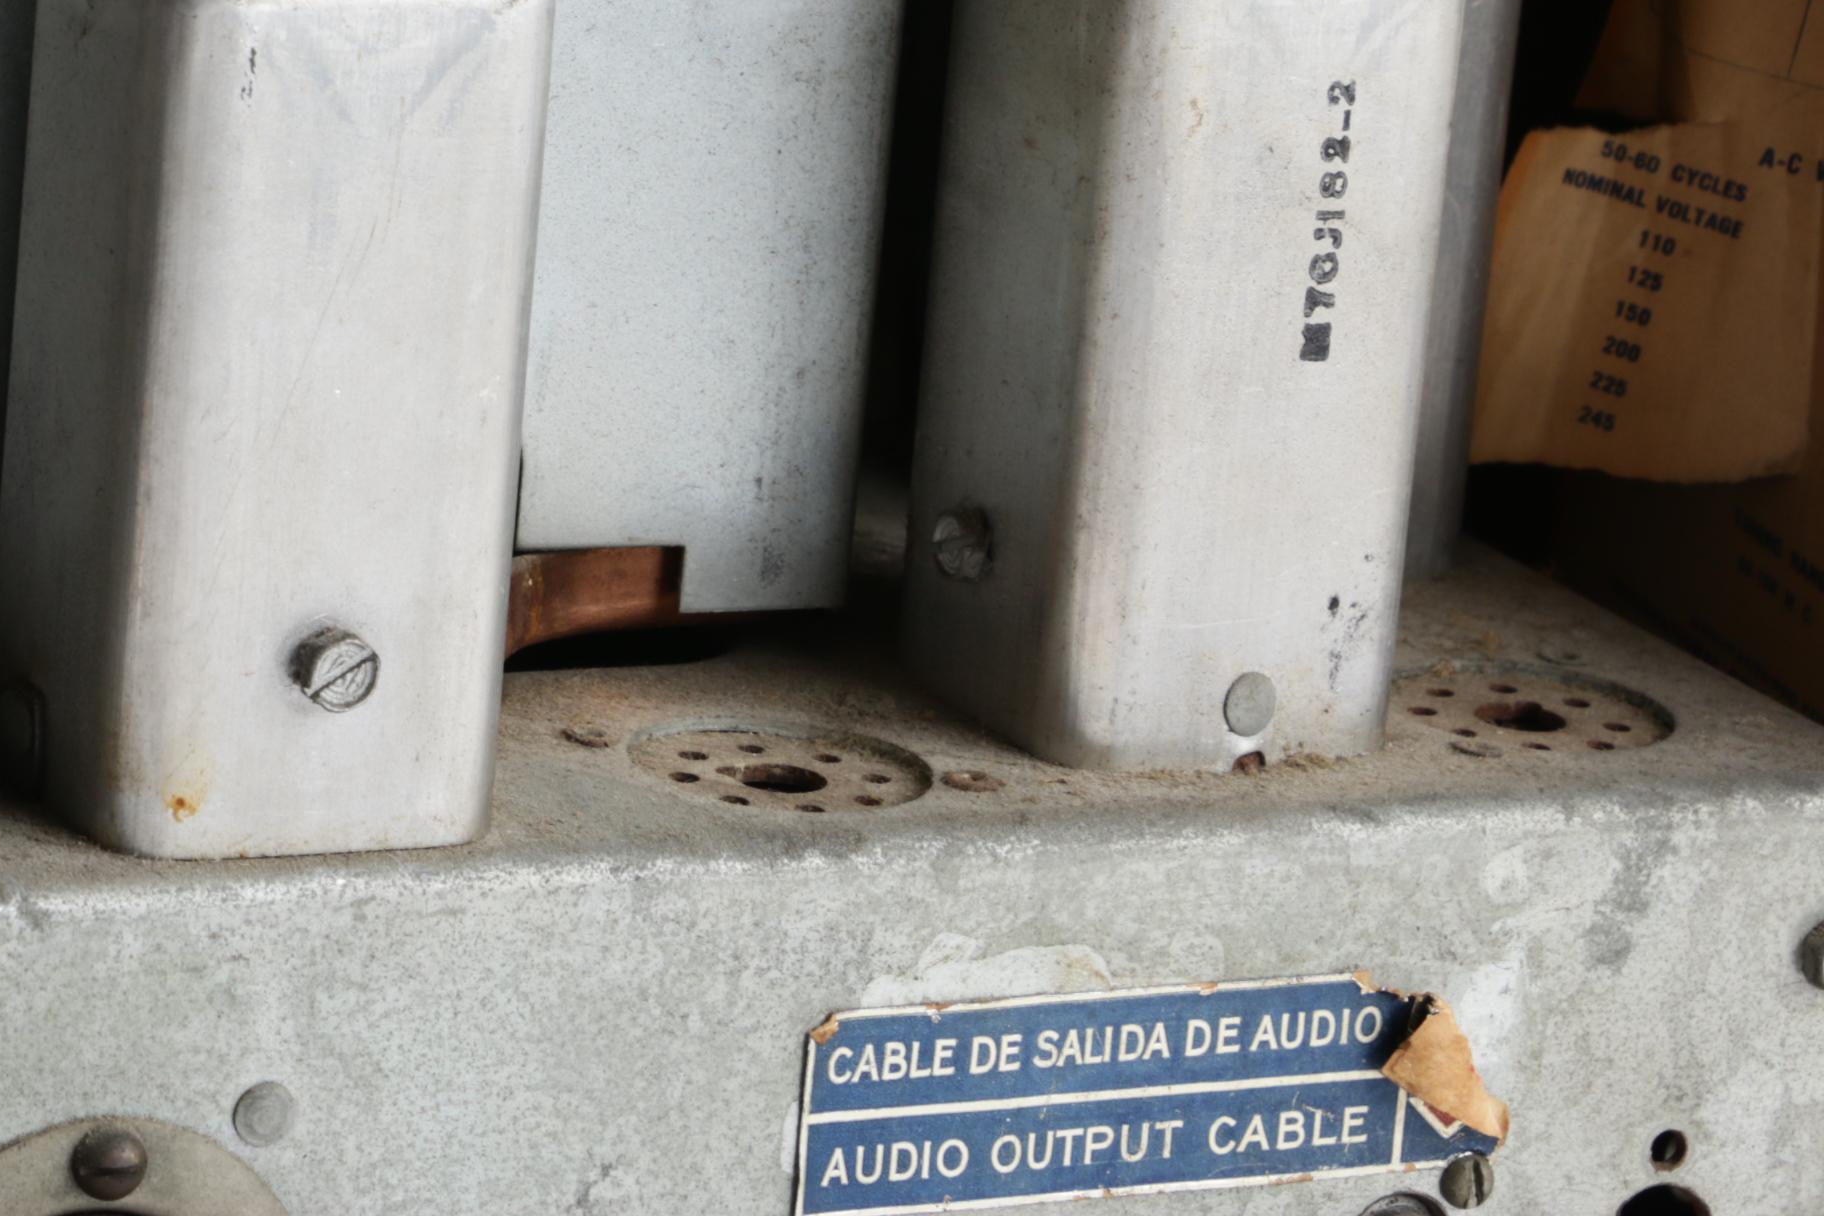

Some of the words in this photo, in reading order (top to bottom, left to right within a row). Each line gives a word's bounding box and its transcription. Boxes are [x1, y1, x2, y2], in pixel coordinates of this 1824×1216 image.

[1601, 141, 1661, 173] 50-60
[1670, 164, 1748, 202] CYCLES
[1562, 169, 1646, 208] NOMINAL
[1656, 195, 1744, 239] VOLTAGE
[1639, 230, 1676, 255] 110
[1627, 266, 1663, 291] 125
[1614, 301, 1652, 326] 150
[1602, 336, 1641, 362] 200
[1577, 406, 1616, 432] 245
[827, 1038, 957, 1084] CABLE
[969, 1034, 1021, 1075] DE
[1033, 1022, 1170, 1068] SALIDA
[1185, 1017, 1244, 1057] DE
[1249, 1005, 1382, 1053] AUDIO
[821, 1137, 969, 1187] AUDIO
[990, 1120, 1182, 1174] OUTPUT
[1208, 1106, 1369, 1155] CABLE
